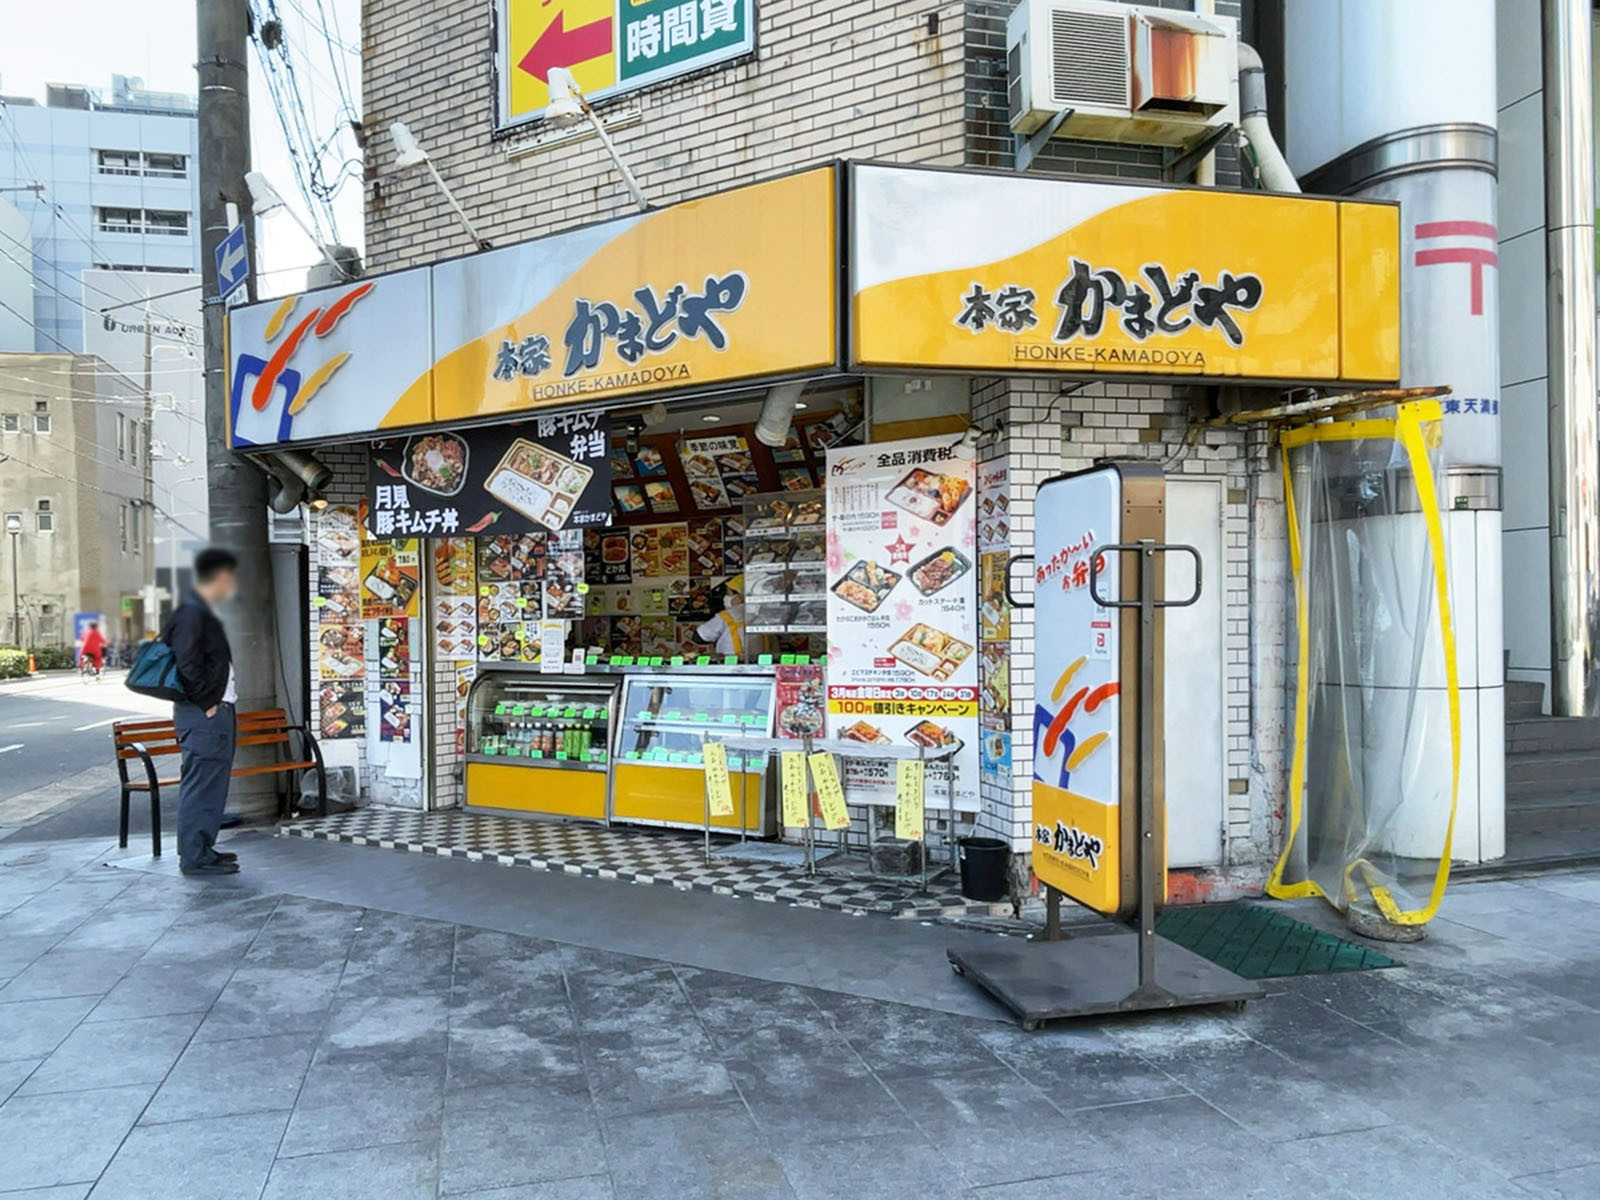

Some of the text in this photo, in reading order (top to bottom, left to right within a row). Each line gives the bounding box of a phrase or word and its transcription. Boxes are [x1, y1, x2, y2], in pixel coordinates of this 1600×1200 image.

[626, 0, 738, 63] 時間貸
[956, 257, 1264, 348] 本家 かまどや
[121, 323, 160, 334] URBN
[492, 270, 748, 381] 本家 かまどや
[1014, 344, 1206, 365] HONKE-KAMADOYA
[533, 363, 690, 400] HONKE-KAMADOYA
[570, 430, 607, 461] 弁当
[877, 446, 959, 468] 全品消費税
[375, 484, 411, 510] 月見
[375, 507, 460, 535] 豚キムチ丼
[1053, 821, 1103, 869] かまどや
